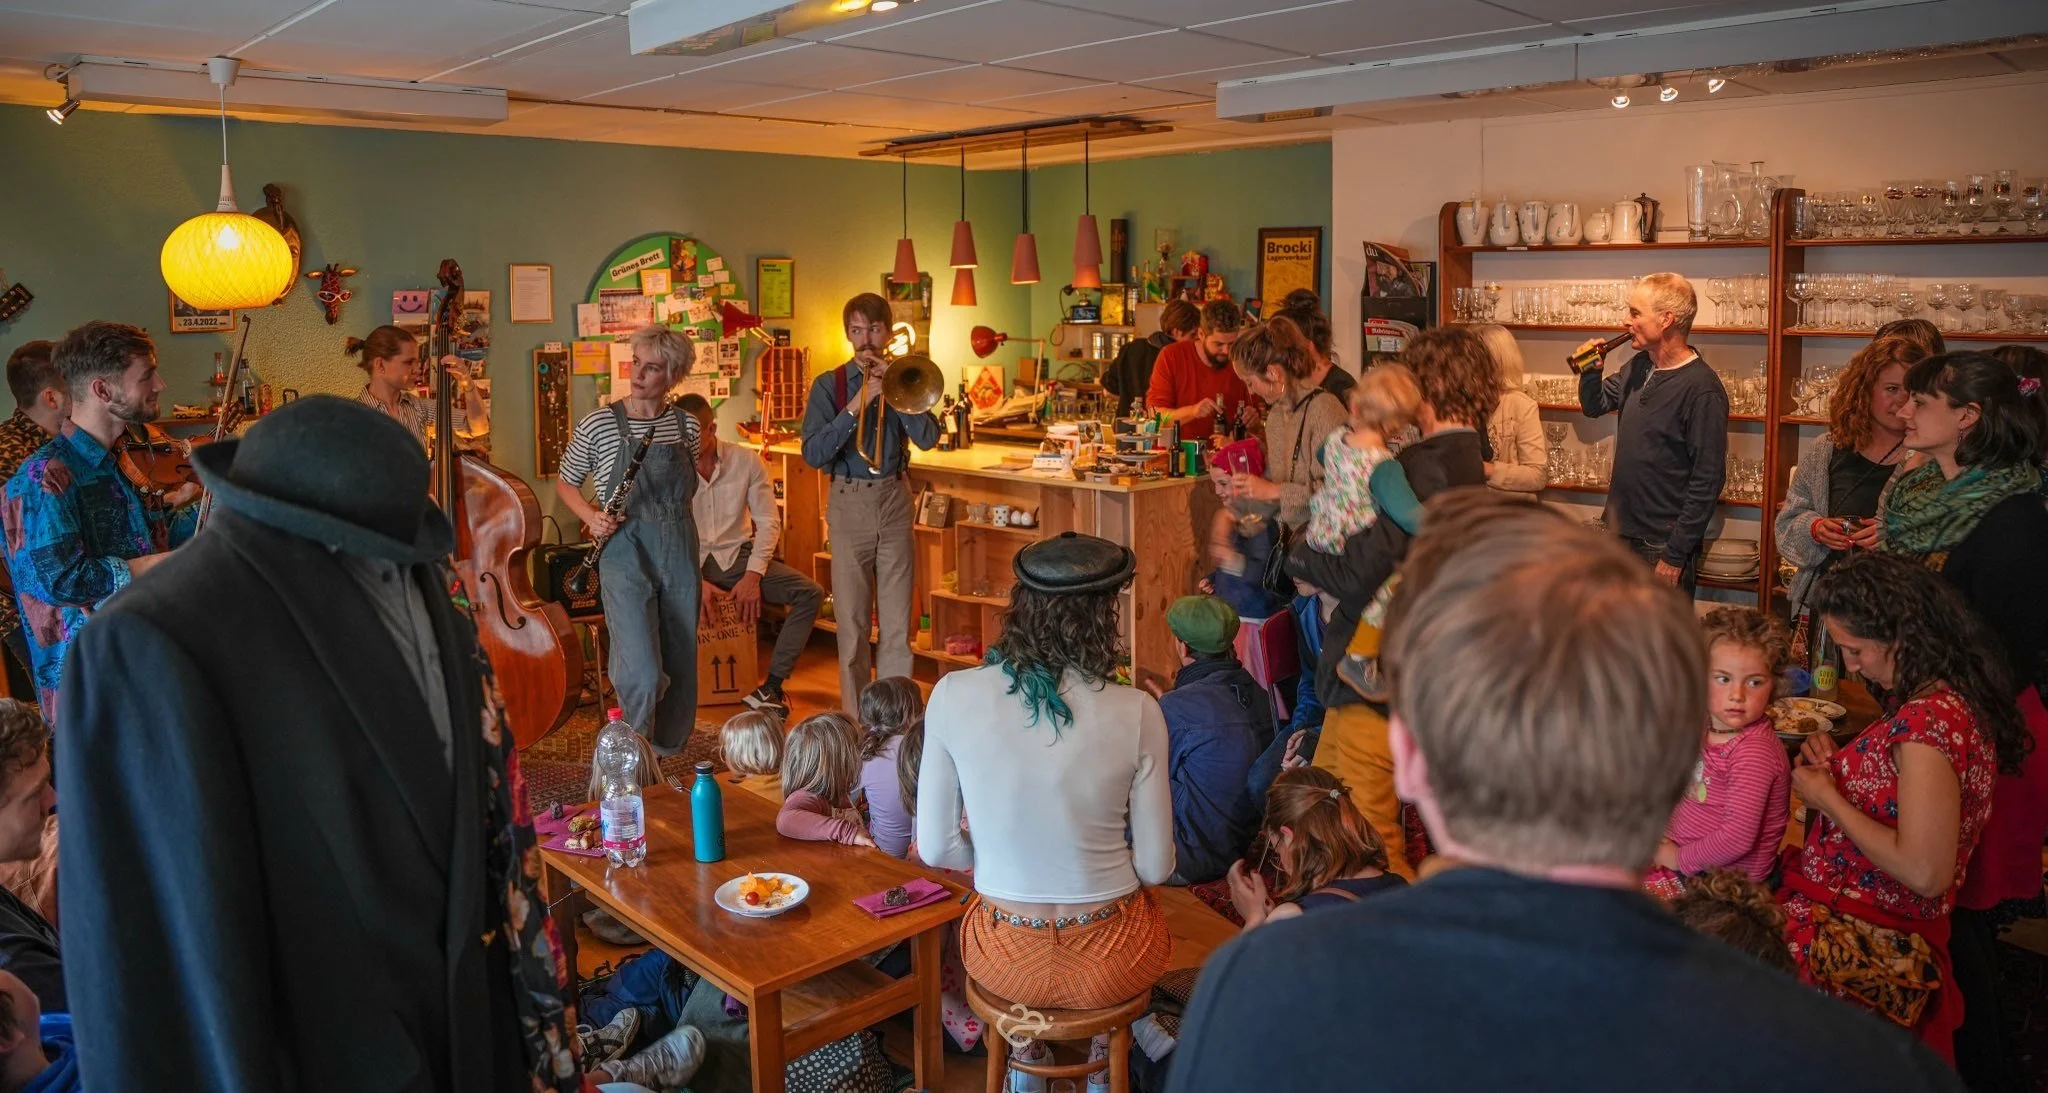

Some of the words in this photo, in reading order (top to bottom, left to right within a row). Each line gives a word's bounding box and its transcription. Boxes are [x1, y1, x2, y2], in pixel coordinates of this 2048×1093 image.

[1267, 241, 1312, 253] Brocki
[1366, 245, 1378, 257] du
[611, 262, 640, 277] Grünes
[639, 253, 660, 266] Brett
[183, 318, 218, 326] 23.4.2022
